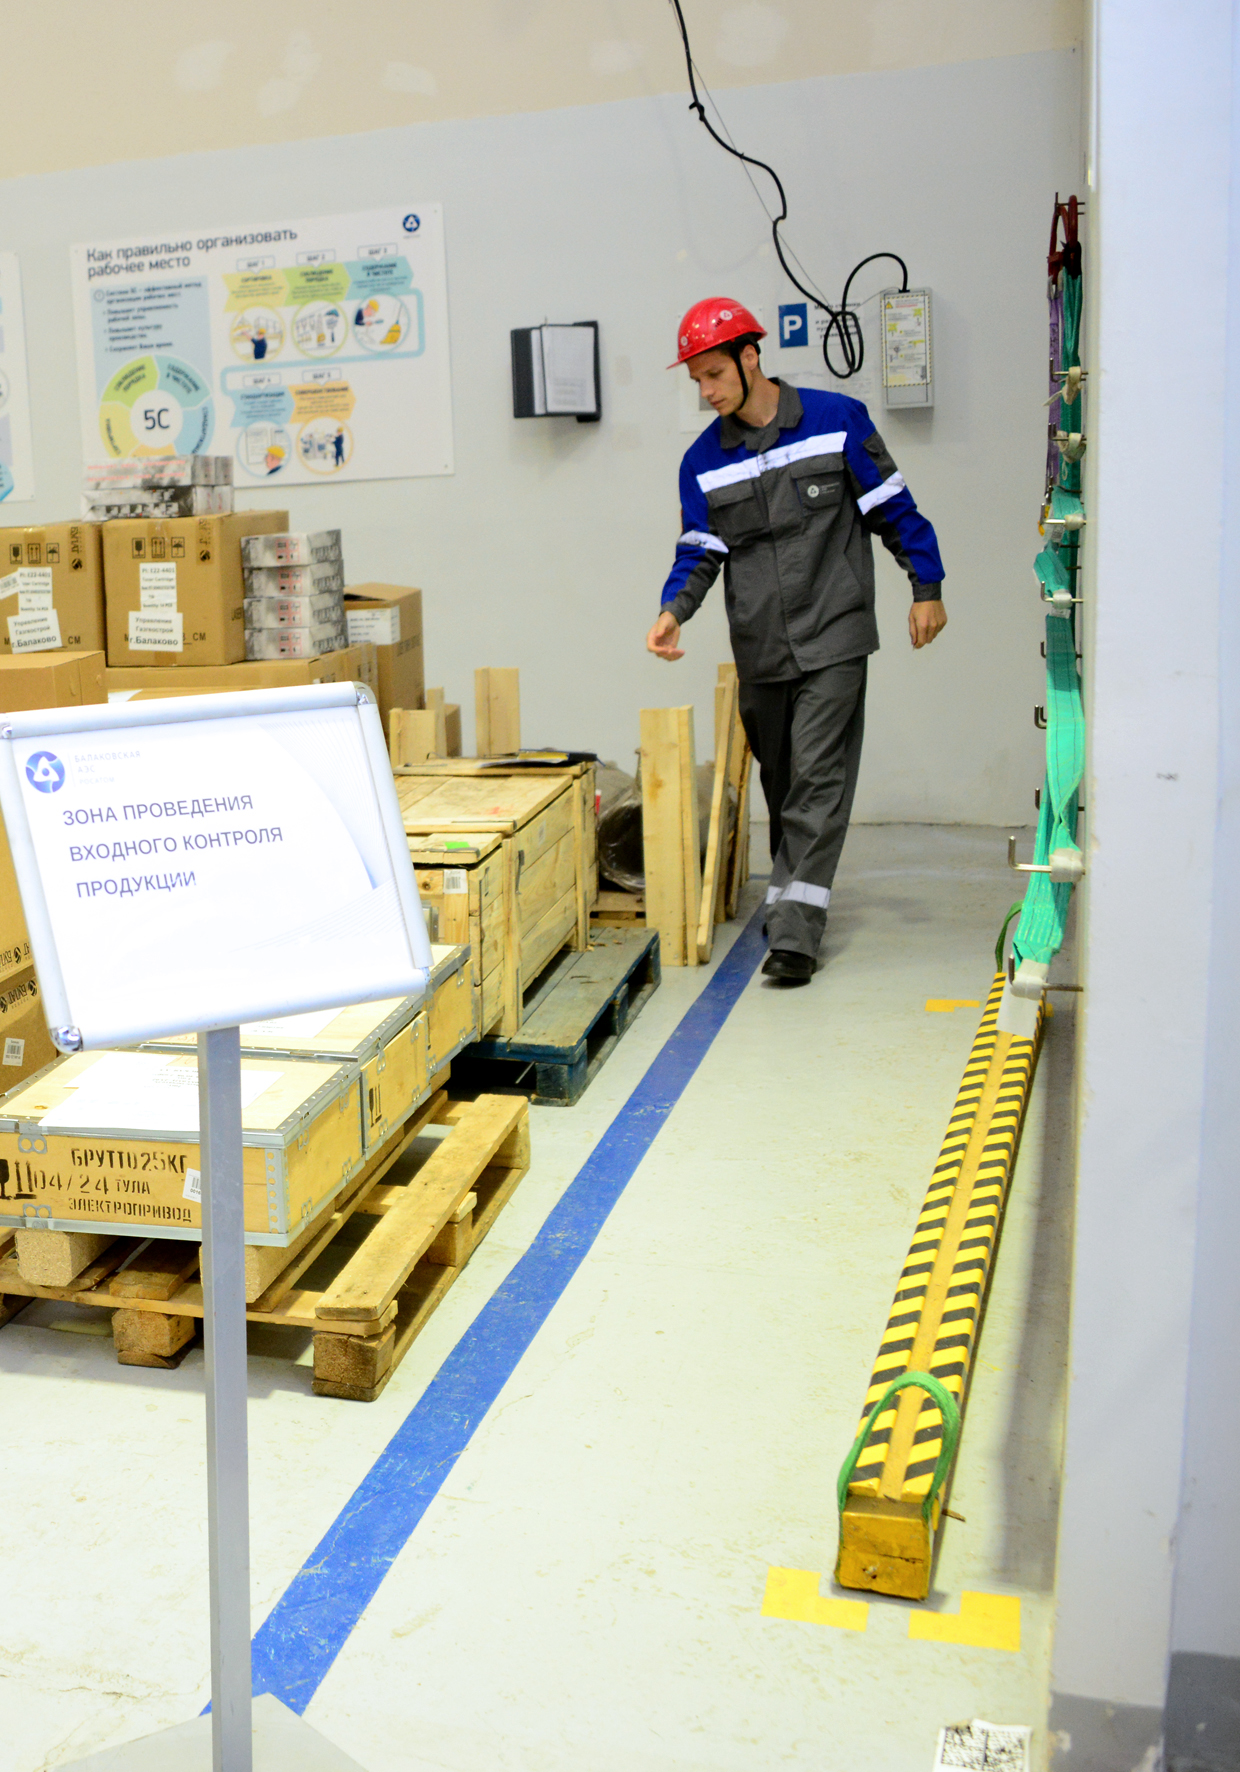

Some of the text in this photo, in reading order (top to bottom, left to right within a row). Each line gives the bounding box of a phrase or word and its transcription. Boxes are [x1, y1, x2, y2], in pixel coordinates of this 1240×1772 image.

[86, 228, 297, 263] Как правильно организовать
[87, 255, 191, 281] рабочее место
[783, 314, 803, 340] P
[143, 407, 171, 431] 5С
[13, 616, 48, 627] Управление
[135, 616, 172, 625] Управление
[11, 635, 57, 648] г.Балаково
[129, 636, 179, 646] г.Балаково
[74, 750, 141, 763] БАЛАКОВСКАЯ
[77, 764, 96, 774] АЭС
[79, 776, 115, 785] РОСАТОМ
[62, 794, 254, 827] ЗОНА ПРОВЕДЕНИЯ
[69, 826, 284, 863] ВХОДНОГО КОНТРОЛЯ
[76, 870, 197, 898] ПРОДУКЦИИ
[114, 1178, 151, 1195] ТУЛА
[68, 1197, 192, 1223] ЭЛЕКТРОПРИВОД
